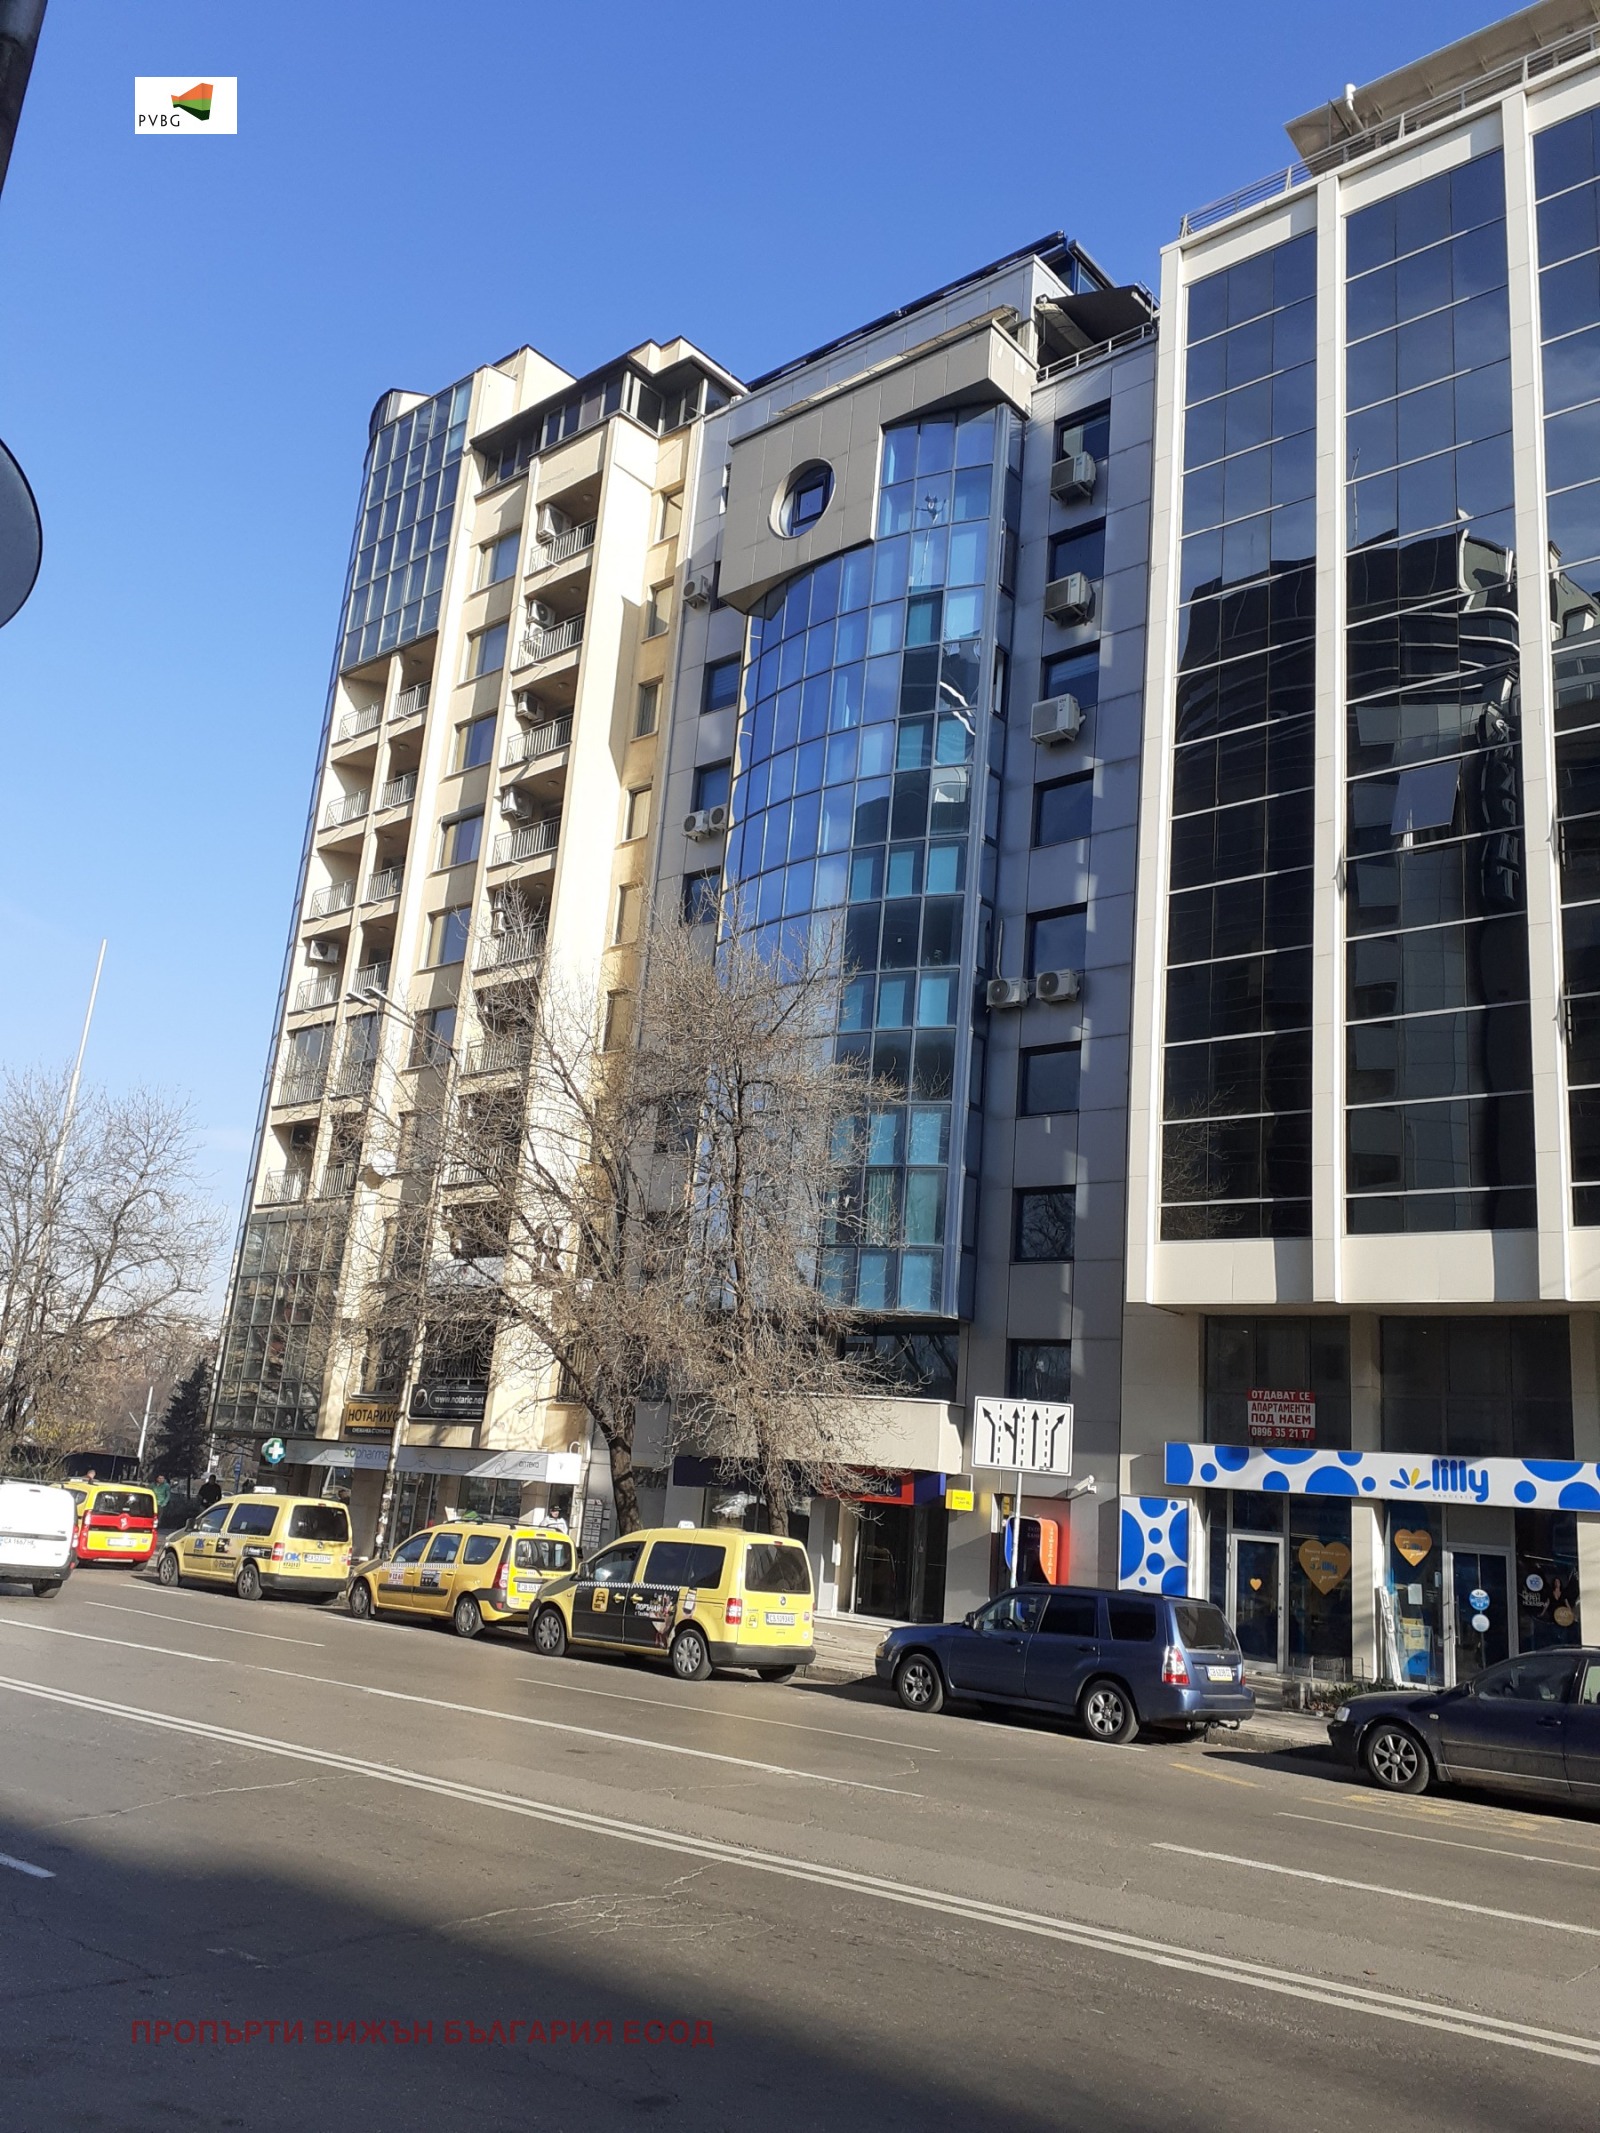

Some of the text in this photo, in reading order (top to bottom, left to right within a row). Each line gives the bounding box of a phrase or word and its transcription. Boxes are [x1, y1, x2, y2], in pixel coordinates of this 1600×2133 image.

[1251, 1390, 1311, 1401] ОТДАВАТ СЕ
[1251, 1402, 1311, 1414] АПАРТАМЕНТИ
[347, 1409, 398, 1423] НОТАРИУС
[1251, 1413, 1312, 1425] ПОД НАЕМ
[1251, 1427, 1272, 1437] 0896
[1275, 1428, 1286, 1438] 35
[1289, 1428, 1298, 1438] 21
[1432, 1459, 1489, 1502] lilly
[285, 1552, 301, 1561] OK
